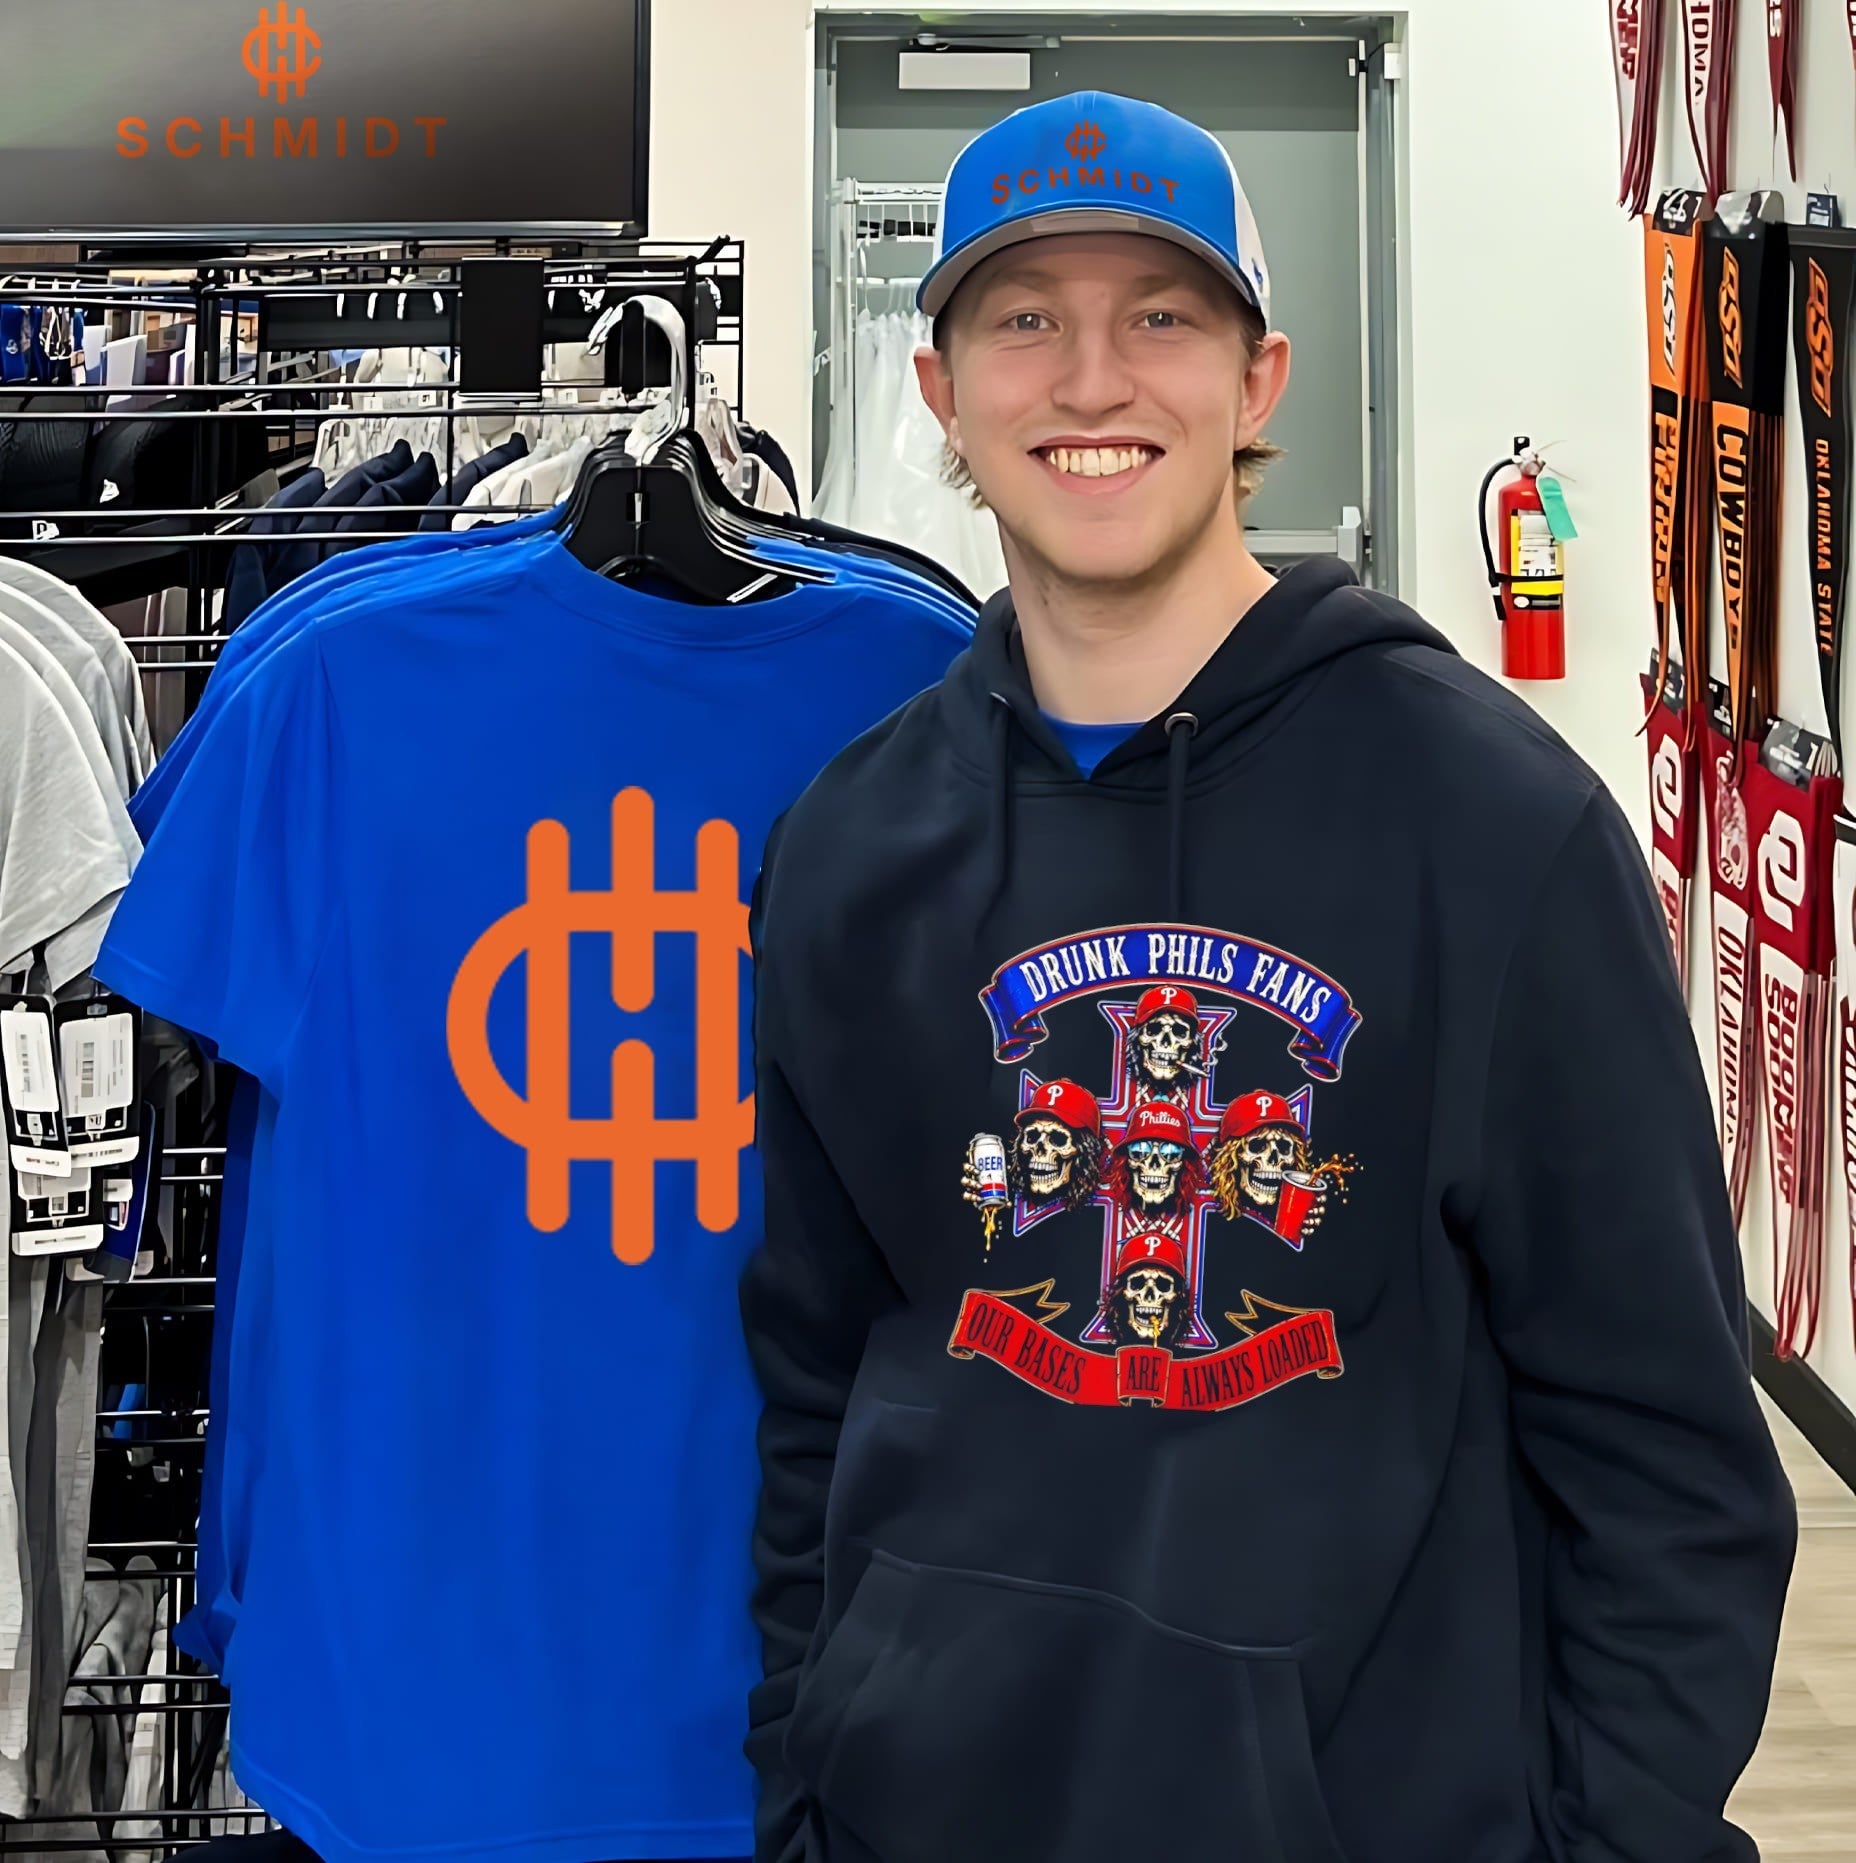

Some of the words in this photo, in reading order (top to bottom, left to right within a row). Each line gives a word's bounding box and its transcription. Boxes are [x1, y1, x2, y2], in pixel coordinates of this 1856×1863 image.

[115, 116, 447, 159] SCHMIDT
[991, 167, 1179, 204] SCHMIDT
[1816, 438, 1832, 570] OKLAHOMA
[1020, 935, 1131, 1002] DRUNK
[1147, 933, 1239, 984] PHILS
[1246, 952, 1332, 1024] FANS
[1160, 987, 1177, 1005] P
[1047, 1085, 1064, 1106] P
[1255, 1096, 1272, 1117] P
[1139, 1110, 1181, 1128] Phillies
[977, 1156, 1003, 1171] BEER
[1144, 1237, 1161, 1256] P
[966, 1302, 1009, 1352] OUR
[1014, 1326, 1086, 1396] BASES
[1125, 1355, 1161, 1393] ARE
[1181, 1352, 1254, 1408] ALWAYS
[1257, 1320, 1329, 1376] LOADED
